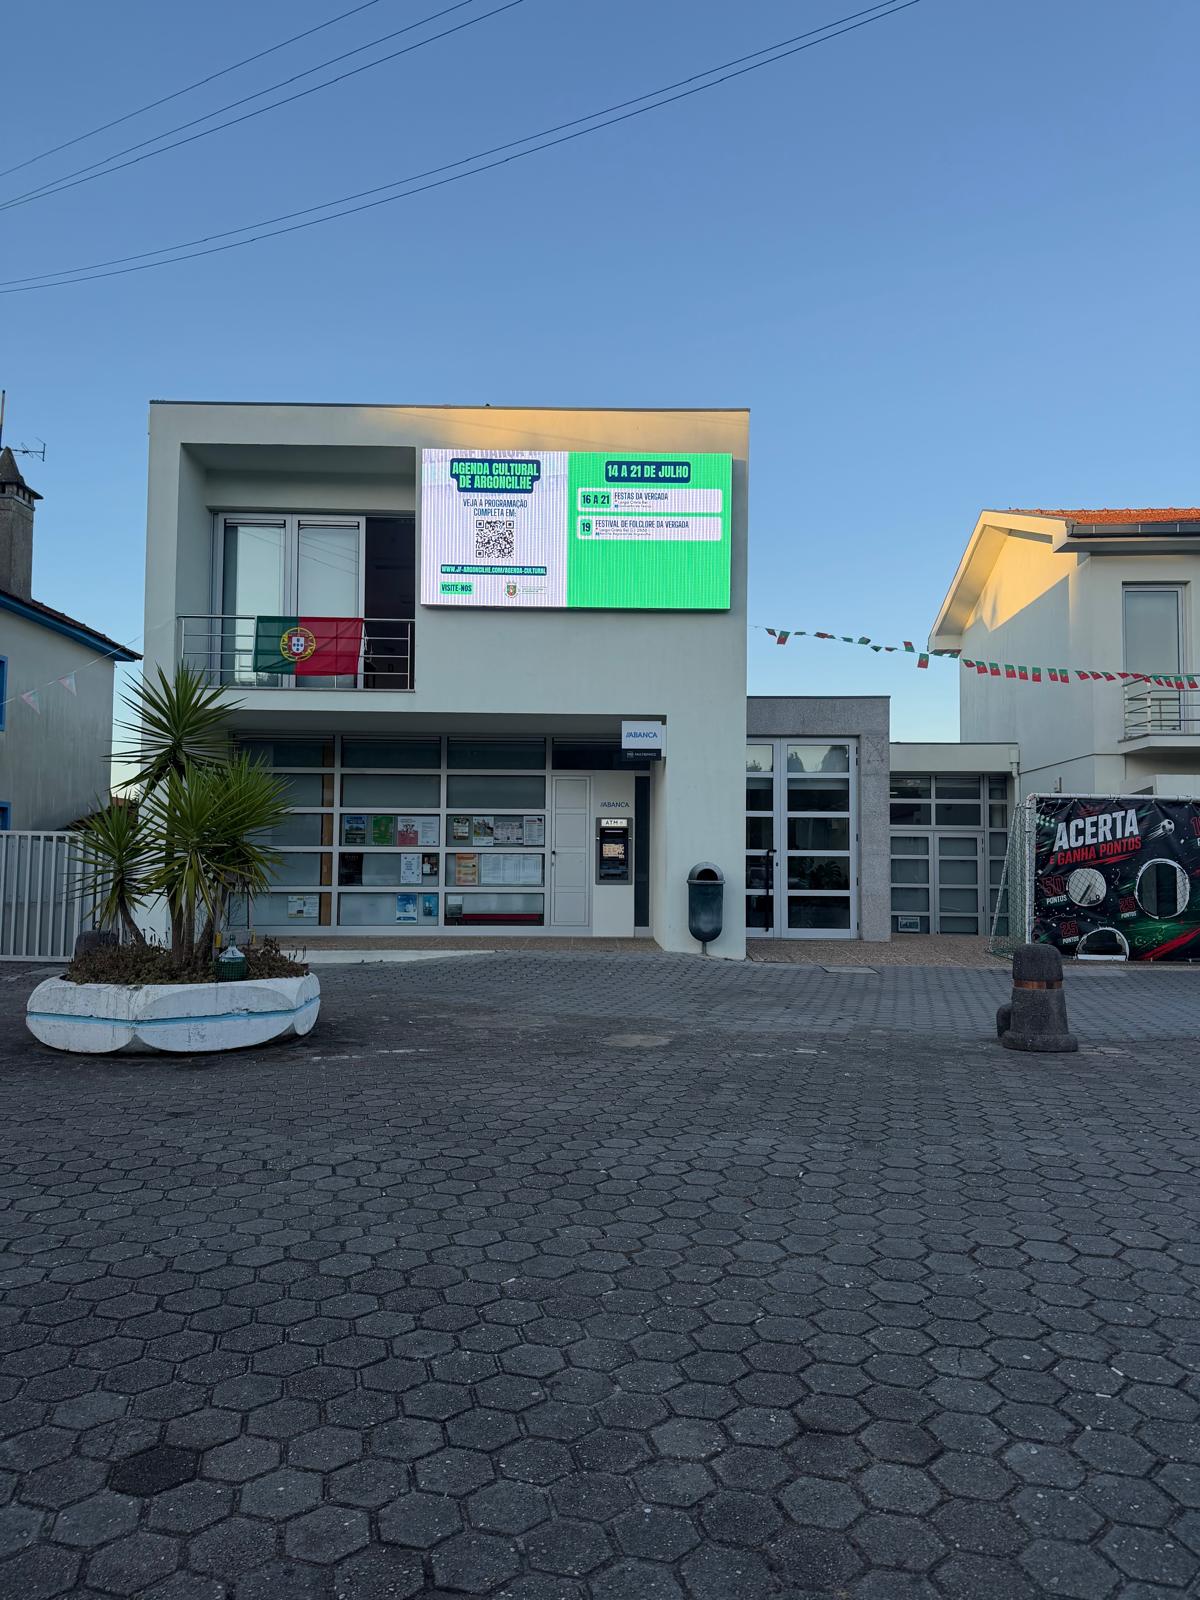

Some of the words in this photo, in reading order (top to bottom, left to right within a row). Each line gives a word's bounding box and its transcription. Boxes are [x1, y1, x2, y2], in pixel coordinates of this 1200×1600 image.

[452, 462, 490, 475] AGENDA
[492, 463, 538, 476] CULTURAL
[607, 465, 618, 477] 14
[622, 466, 628, 477] A
[630, 466, 642, 477] 21
[644, 466, 656, 478] DE
[658, 466, 688, 478] JULHO
[459, 475, 472, 488] DE
[474, 475, 532, 490] ARGONCILHE
[582, 495, 591, 504] 16
[593, 495, 599, 504] A
[601, 495, 610, 504] 21
[614, 492, 635, 500] FESTAS
[463, 499, 478, 507] VEJA
[479, 499, 483, 507] A
[485, 499, 528, 509] PROGRAMAÇÃO
[473, 508, 505, 517] COMPLETA
[505, 508, 517, 517] EM:
[581, 522, 591, 531] 19
[595, 520, 619, 528] FESTIVAL
[620, 520, 628, 528] DE
[629, 520, 656, 528] FOLCLORE
[656, 520, 664, 529] DA
[441, 583, 472, 592] VISITE-NOS
[1052, 808, 1139, 852] ACERTA
[1049, 855, 1055, 865] E
[1057, 846, 1097, 866] GANHA
[1099, 836, 1142, 858] PONTOS
[1041, 875, 1066, 897] 50
[1046, 895, 1068, 905] PONTOS
[1119, 897, 1136, 912] 25
[1121, 910, 1137, 918] PONTOS
[1060, 920, 1079, 938] 25
[1062, 935, 1080, 944] PONTOS
